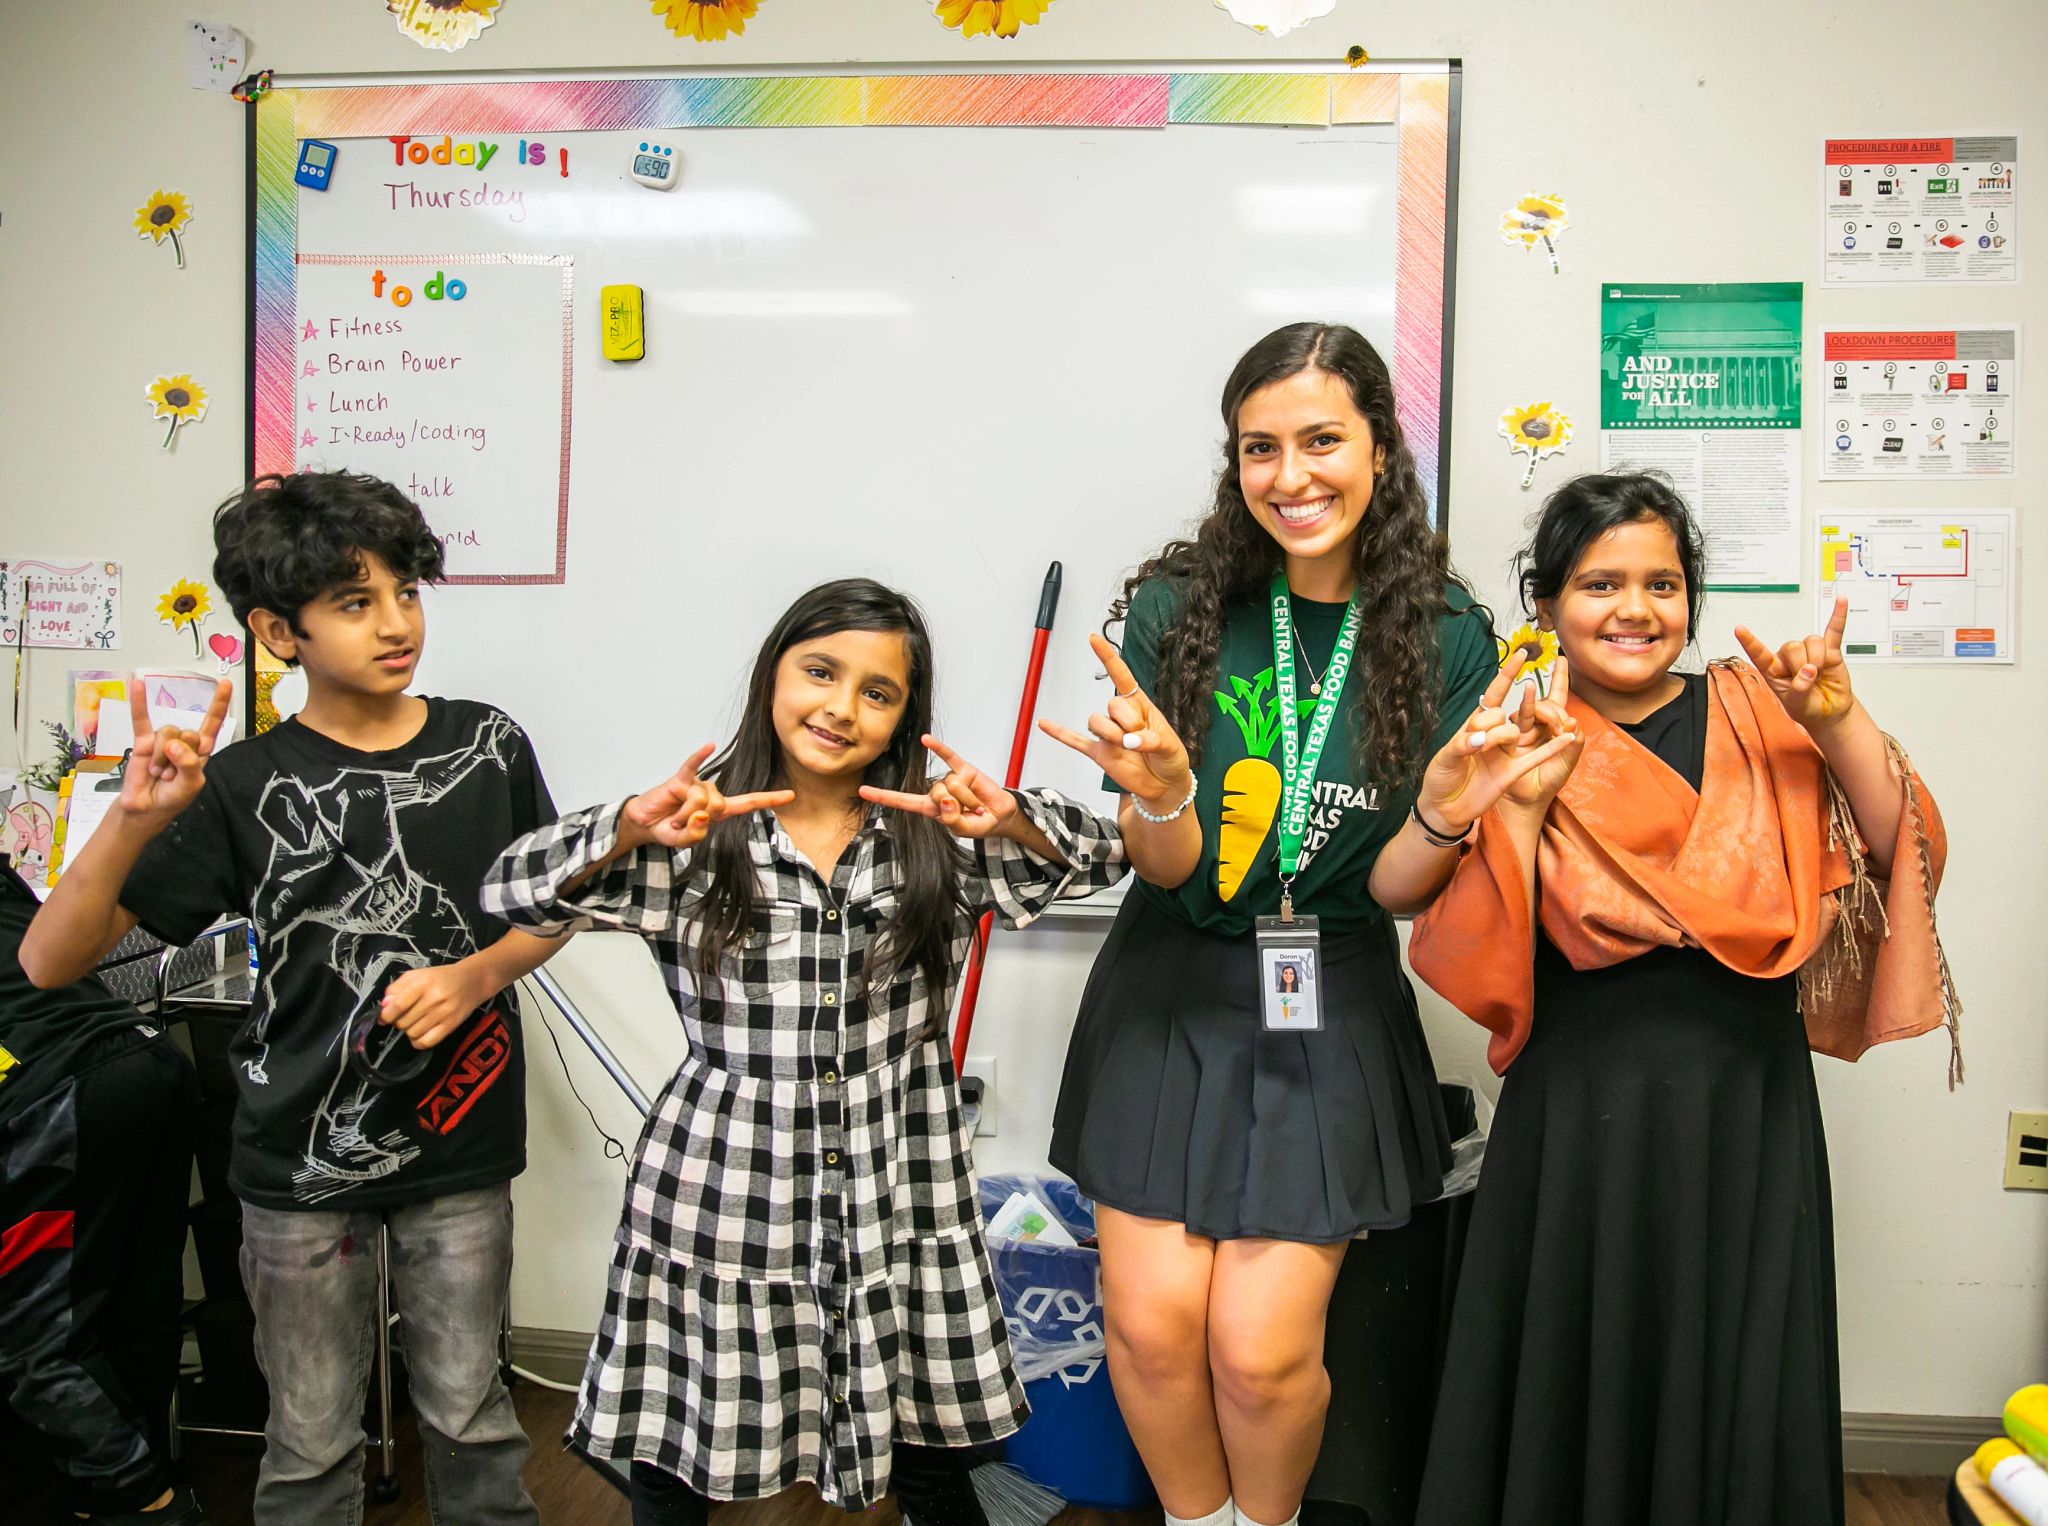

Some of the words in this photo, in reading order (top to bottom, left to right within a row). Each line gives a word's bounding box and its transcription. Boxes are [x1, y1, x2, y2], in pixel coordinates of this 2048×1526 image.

[389, 135, 499, 171] Today
[519, 139, 546, 166] is
[1827, 143, 1889, 152] PROCEDURES
[1891, 142, 1909, 152] FOR
[1911, 142, 1918, 152] A
[1920, 142, 1942, 151] FIRE
[384, 182, 527, 222] Thursday
[372, 270, 413, 307] to
[424, 270, 467, 300] do
[330, 317, 403, 338] Fitness
[610, 296, 620, 344] VIZ-PRO
[1826, 335, 1886, 346] LOCKDOWN
[1888, 335, 1955, 345] PROCEDURES
[328, 353, 385, 374] Brain
[402, 350, 462, 373] Power
[1622, 356, 1673, 372] AND
[1622, 373, 1719, 389] JUSTICE
[329, 391, 388, 412] Lunch
[1622, 391, 1645, 400] FOR
[1648, 391, 1692, 406] ALL
[408, 472, 454, 498] talk
[48, 582, 78, 593] FULL
[82, 583, 97, 595] OF
[28, 600, 62, 612] LIGHT
[67, 602, 89, 614] AND
[40, 620, 71, 632] LOVE
[1273, 595, 1291, 672] CENTRAL
[1278, 673, 1296, 727] TEXAS
[1283, 730, 1298, 782] FOOD
[1288, 758, 1316, 836] CENTRAL
[1306, 703, 1333, 754] TEXAS
[1323, 652, 1348, 701] FOOD
[1312, 780, 1380, 811] NTRAL
